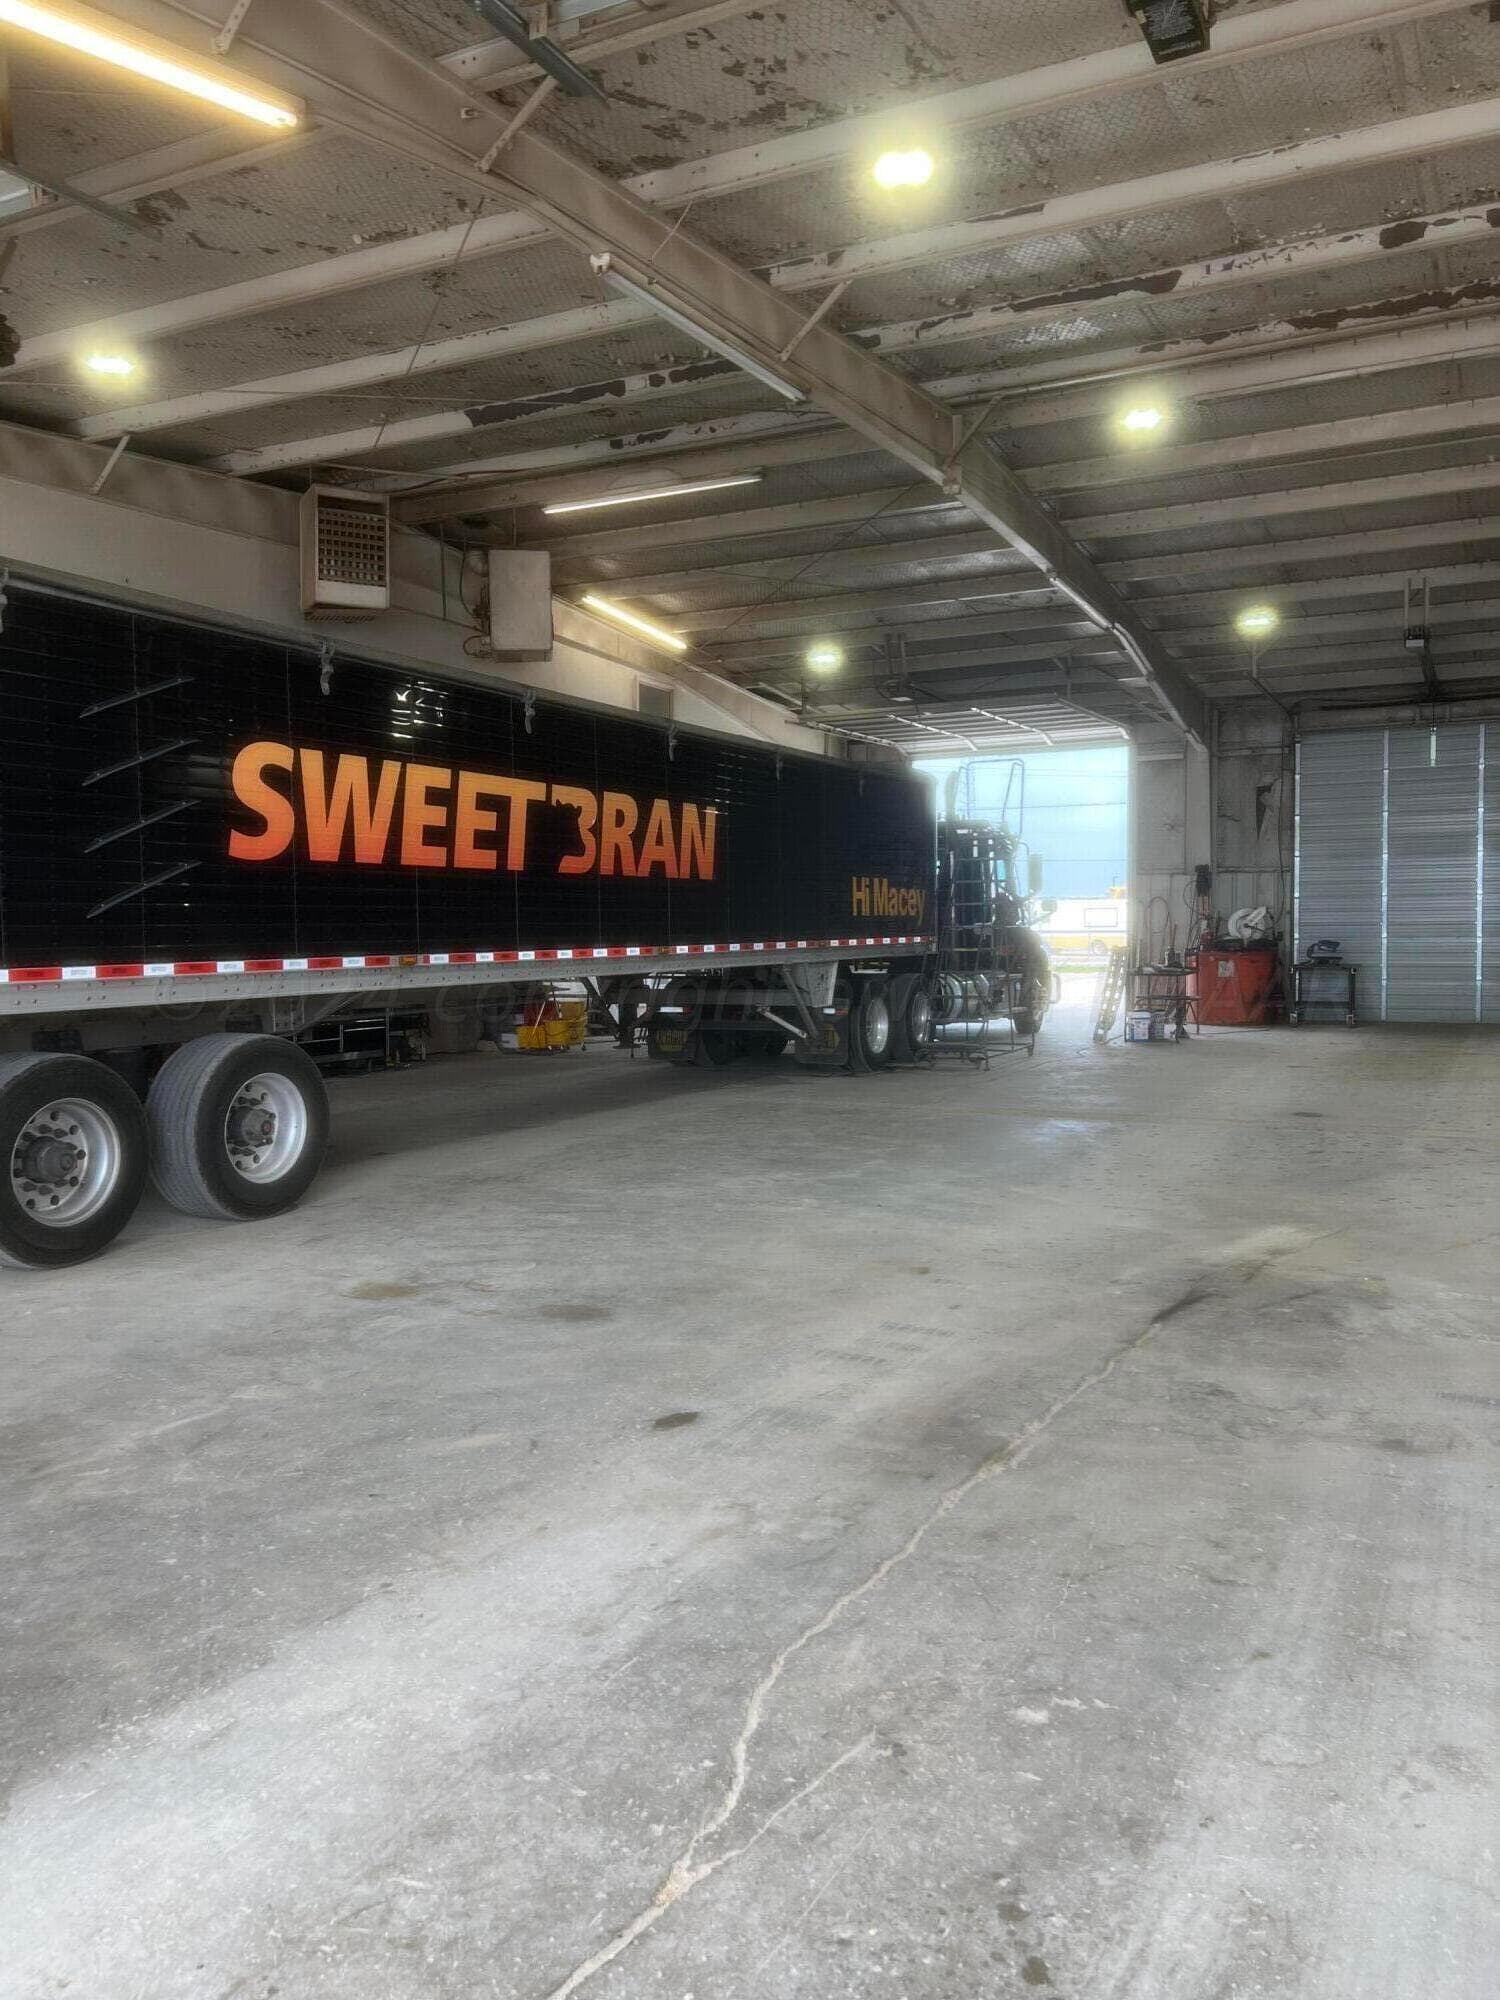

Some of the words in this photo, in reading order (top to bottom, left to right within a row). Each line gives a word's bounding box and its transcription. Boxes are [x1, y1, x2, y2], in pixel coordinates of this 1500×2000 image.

[228, 741, 546, 871] SWEET
[551, 783, 717, 881] BRAN
[852, 876, 870, 916] Hi
[874, 878, 926, 926] Macey
